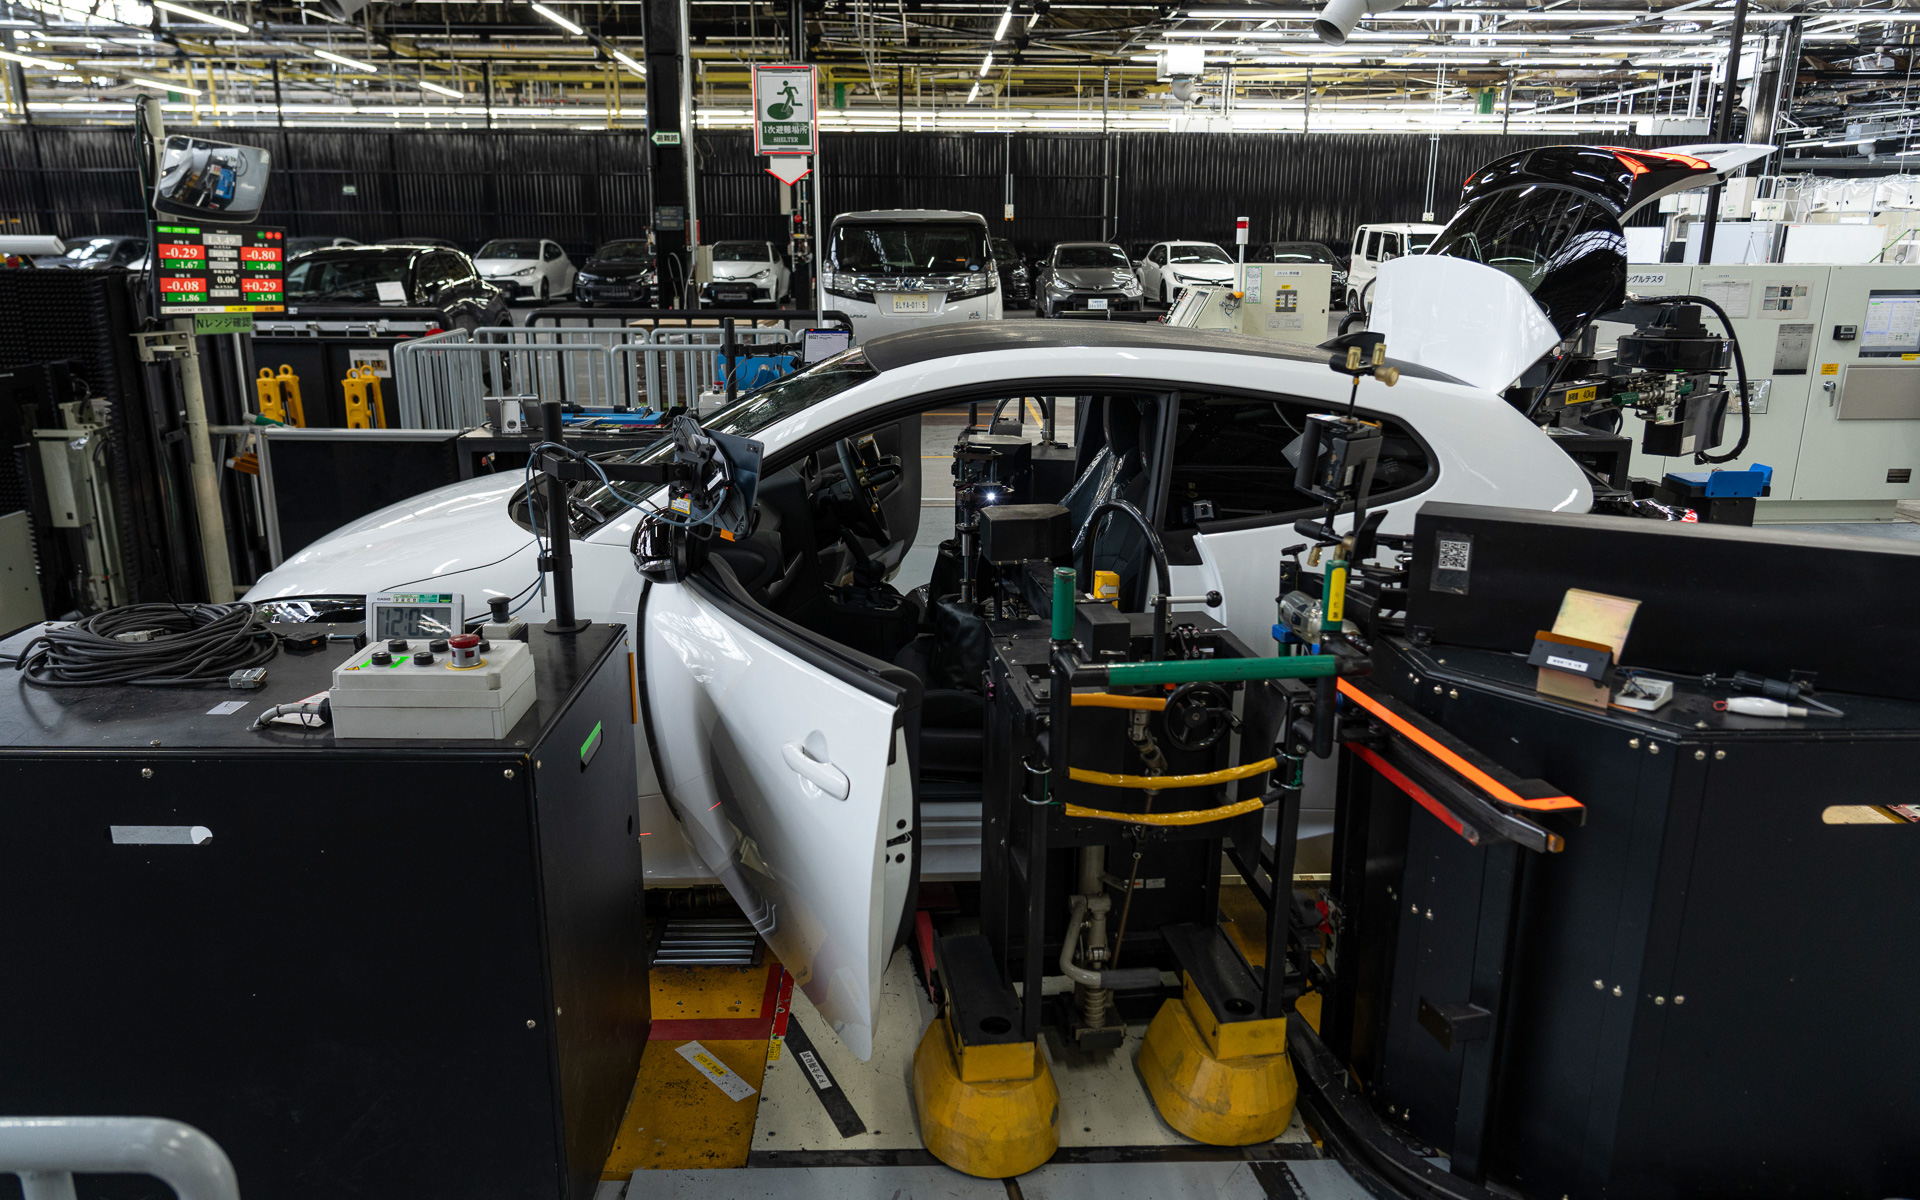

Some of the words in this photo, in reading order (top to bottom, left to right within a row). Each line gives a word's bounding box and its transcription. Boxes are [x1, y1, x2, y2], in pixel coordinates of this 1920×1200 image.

[764, 126, 808, 134] 1次避難場所
[165, 247, 198, 258] -0.29
[247, 250, 275, 260] -0.80
[167, 281, 199, 291] -0.08
[244, 282, 276, 291] +0.29
[196, 317, 251, 328] Nレンジ確認
